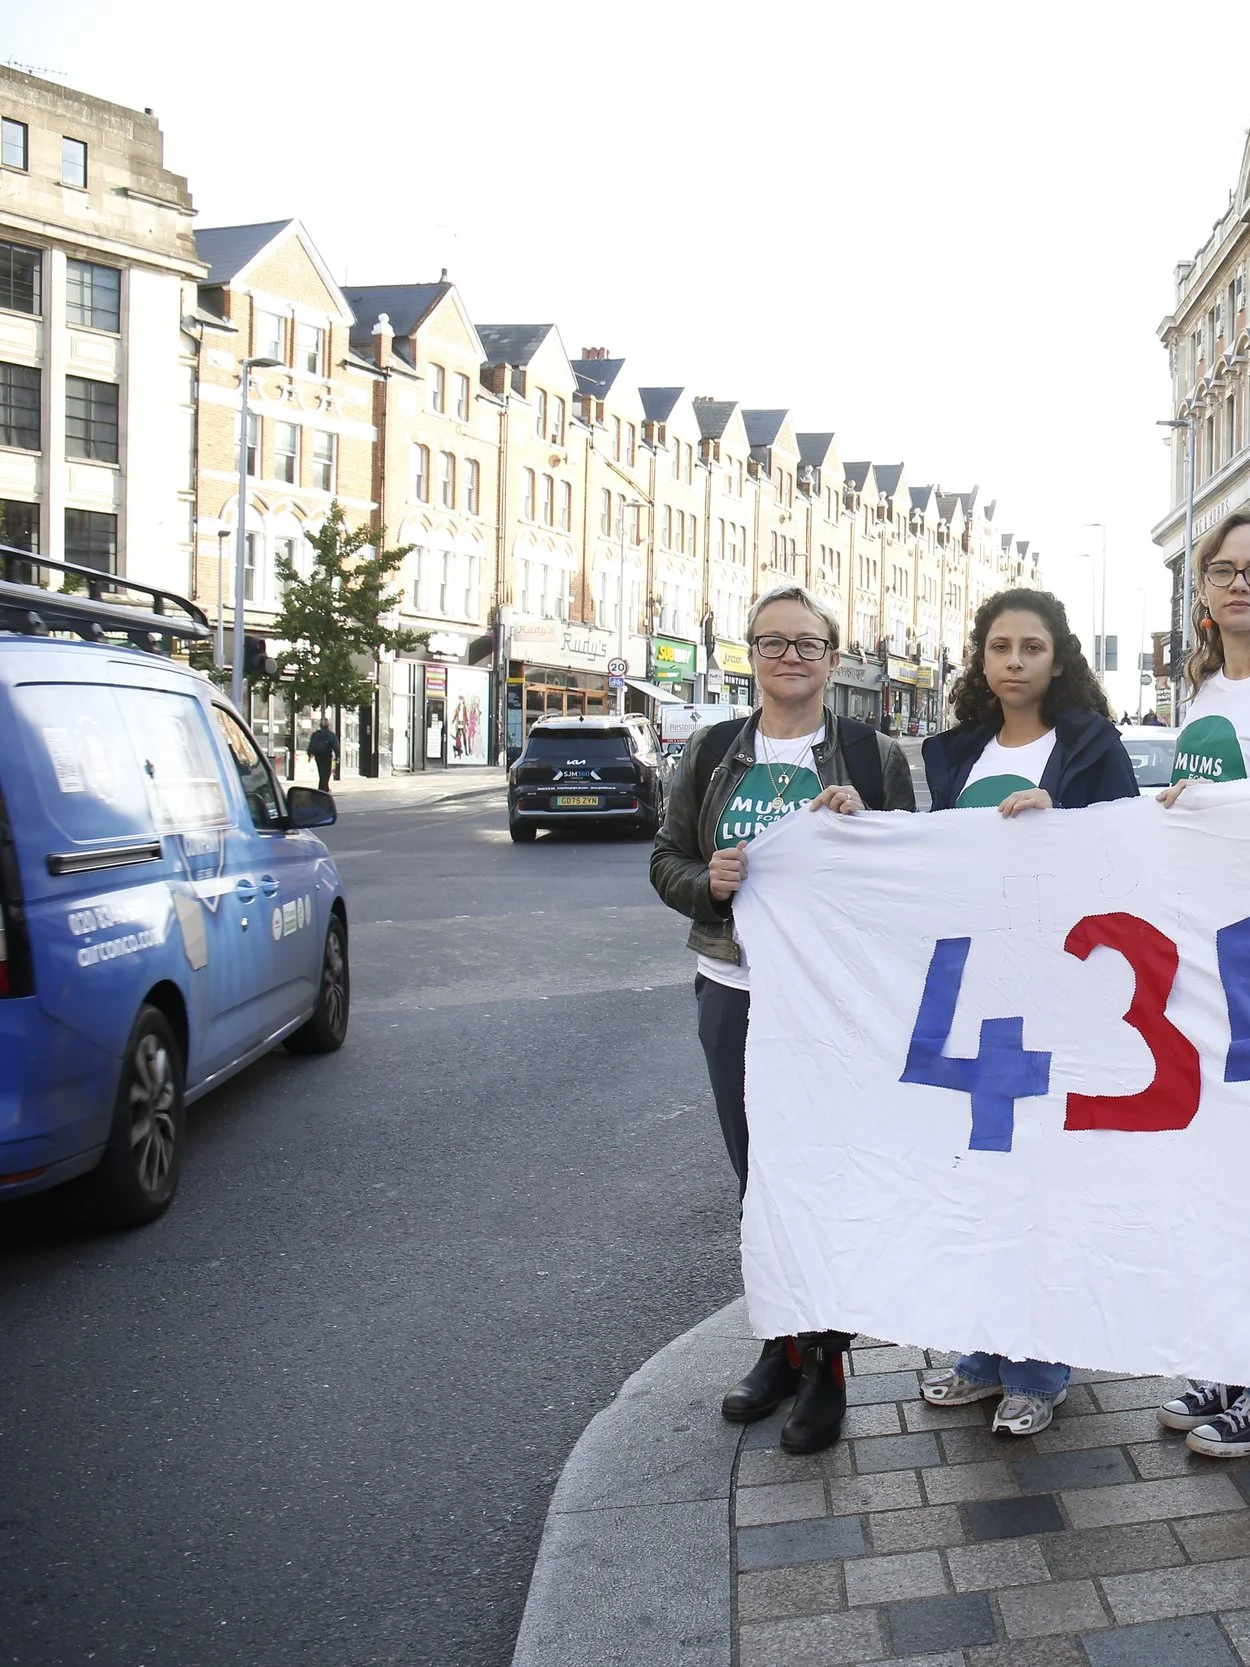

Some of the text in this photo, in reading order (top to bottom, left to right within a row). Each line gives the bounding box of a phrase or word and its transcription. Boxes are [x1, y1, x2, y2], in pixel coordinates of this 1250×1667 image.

[560, 632, 607, 661] Rudy's
[610, 662, 625, 672] 20
[1174, 752, 1223, 777] MUMS
[722, 822, 768, 840] LUN
